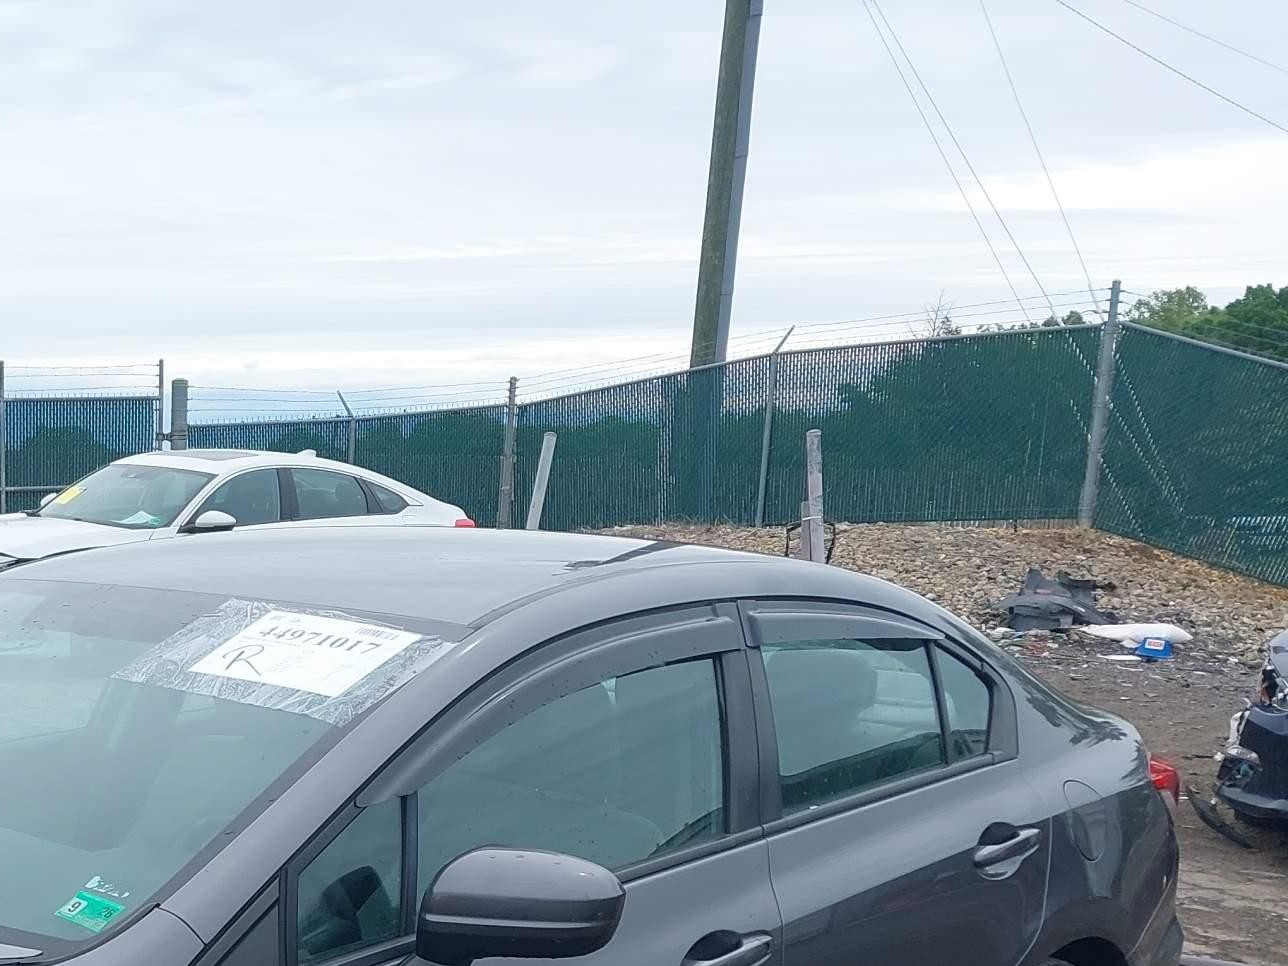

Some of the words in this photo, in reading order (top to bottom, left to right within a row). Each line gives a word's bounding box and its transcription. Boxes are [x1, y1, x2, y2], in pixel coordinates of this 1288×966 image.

[258, 626, 383, 655] 44971017
[222, 644, 265, 677] R
[67, 901, 82, 913] 9
[98, 906, 116, 919] 26
